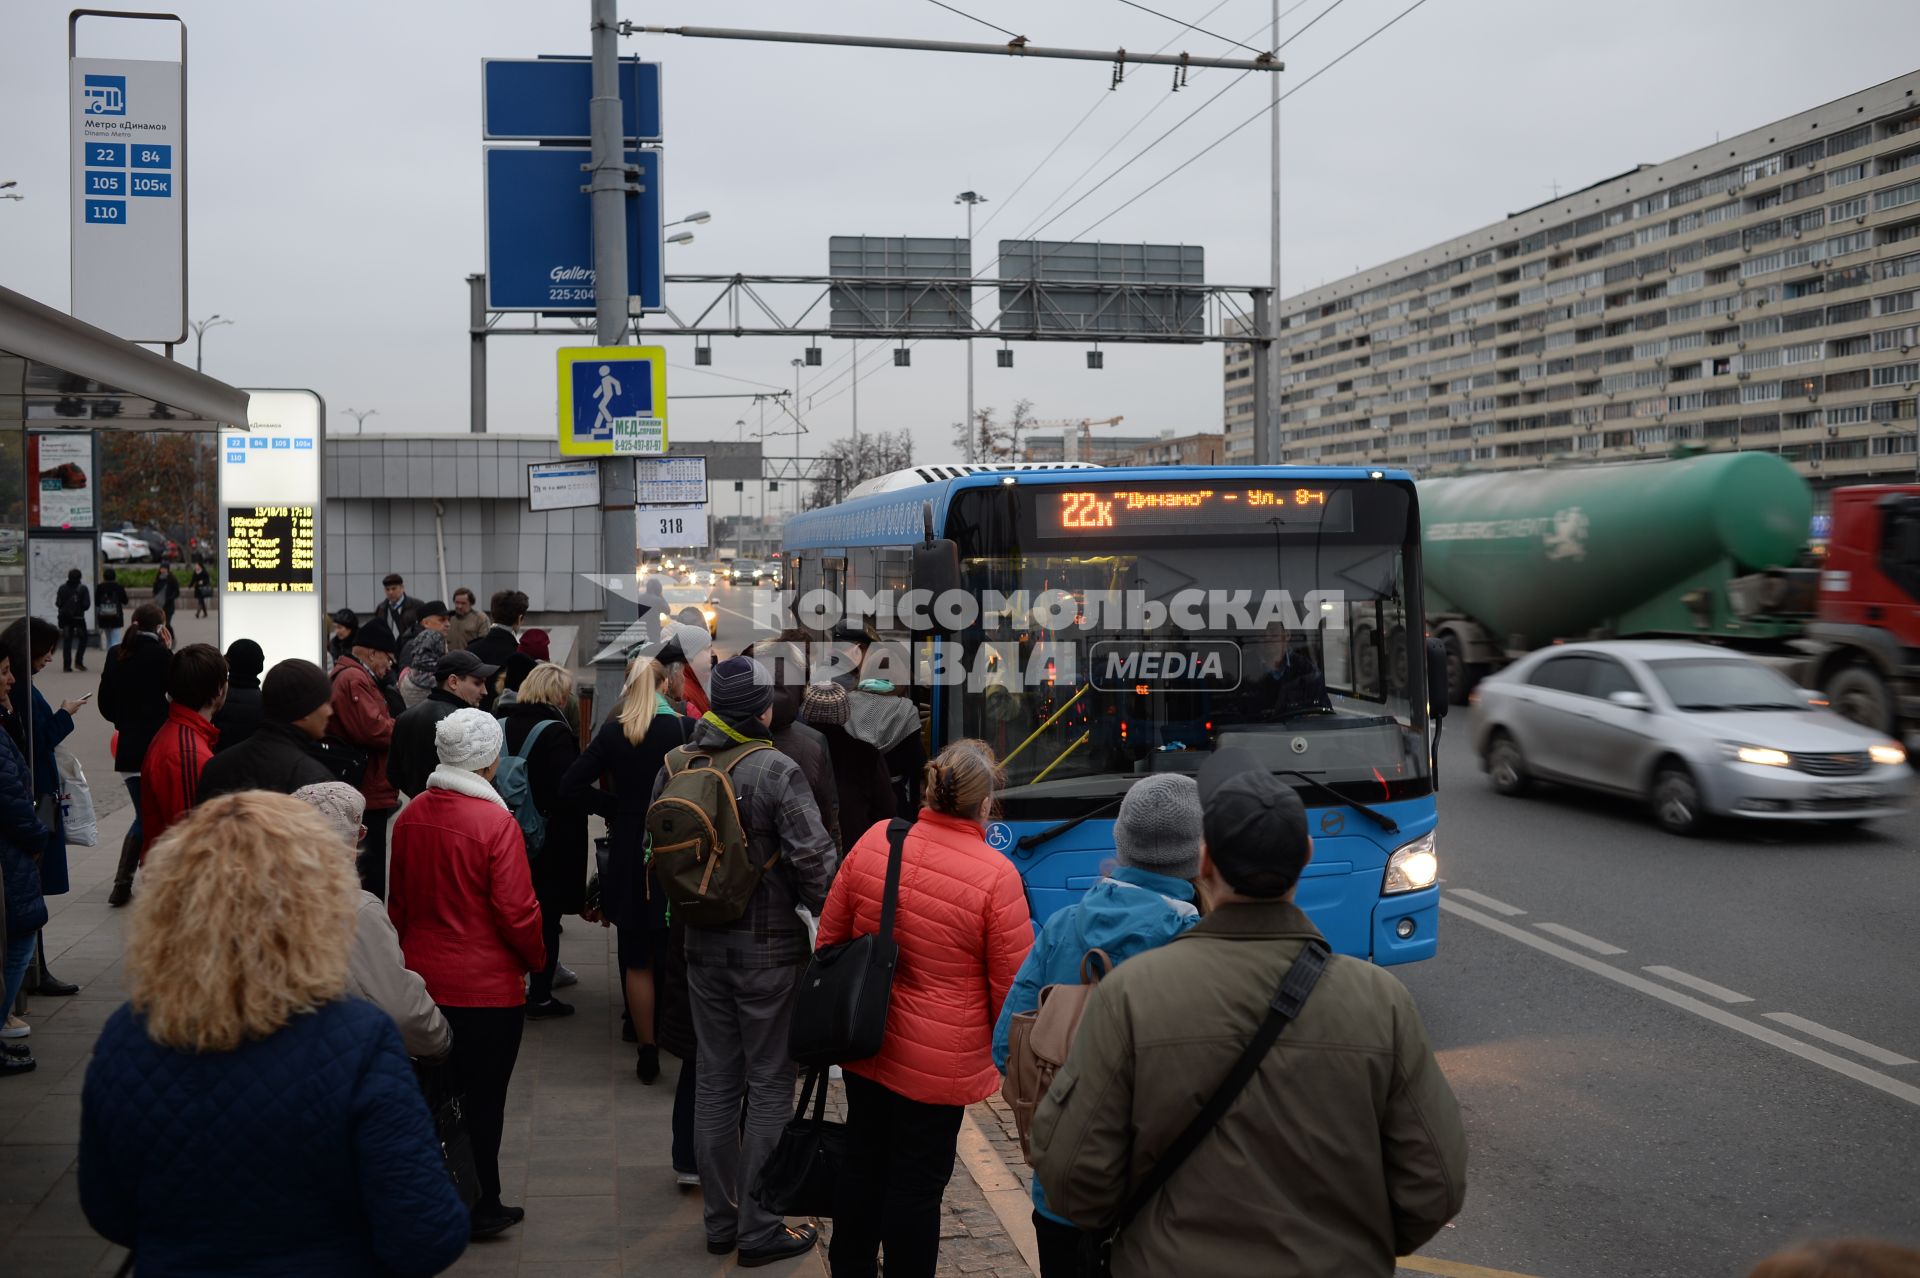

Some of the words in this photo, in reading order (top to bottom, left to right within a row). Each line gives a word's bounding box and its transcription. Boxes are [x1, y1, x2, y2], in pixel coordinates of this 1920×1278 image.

[85, 120, 117, 130] Метро
[119, 121, 167, 130] «Динамо»
[96, 149, 114, 161] 22
[141, 150, 160, 163] 84
[93, 177, 118, 190] 105
[134, 178, 168, 191] 105к
[93, 206, 118, 219] 110
[550, 265, 597, 285] Gallery
[231, 439, 241, 447] 22
[1063, 493, 1113, 527] 22к
[1114, 490, 1214, 509] "Динамо"
[660, 518, 683, 534] 318
